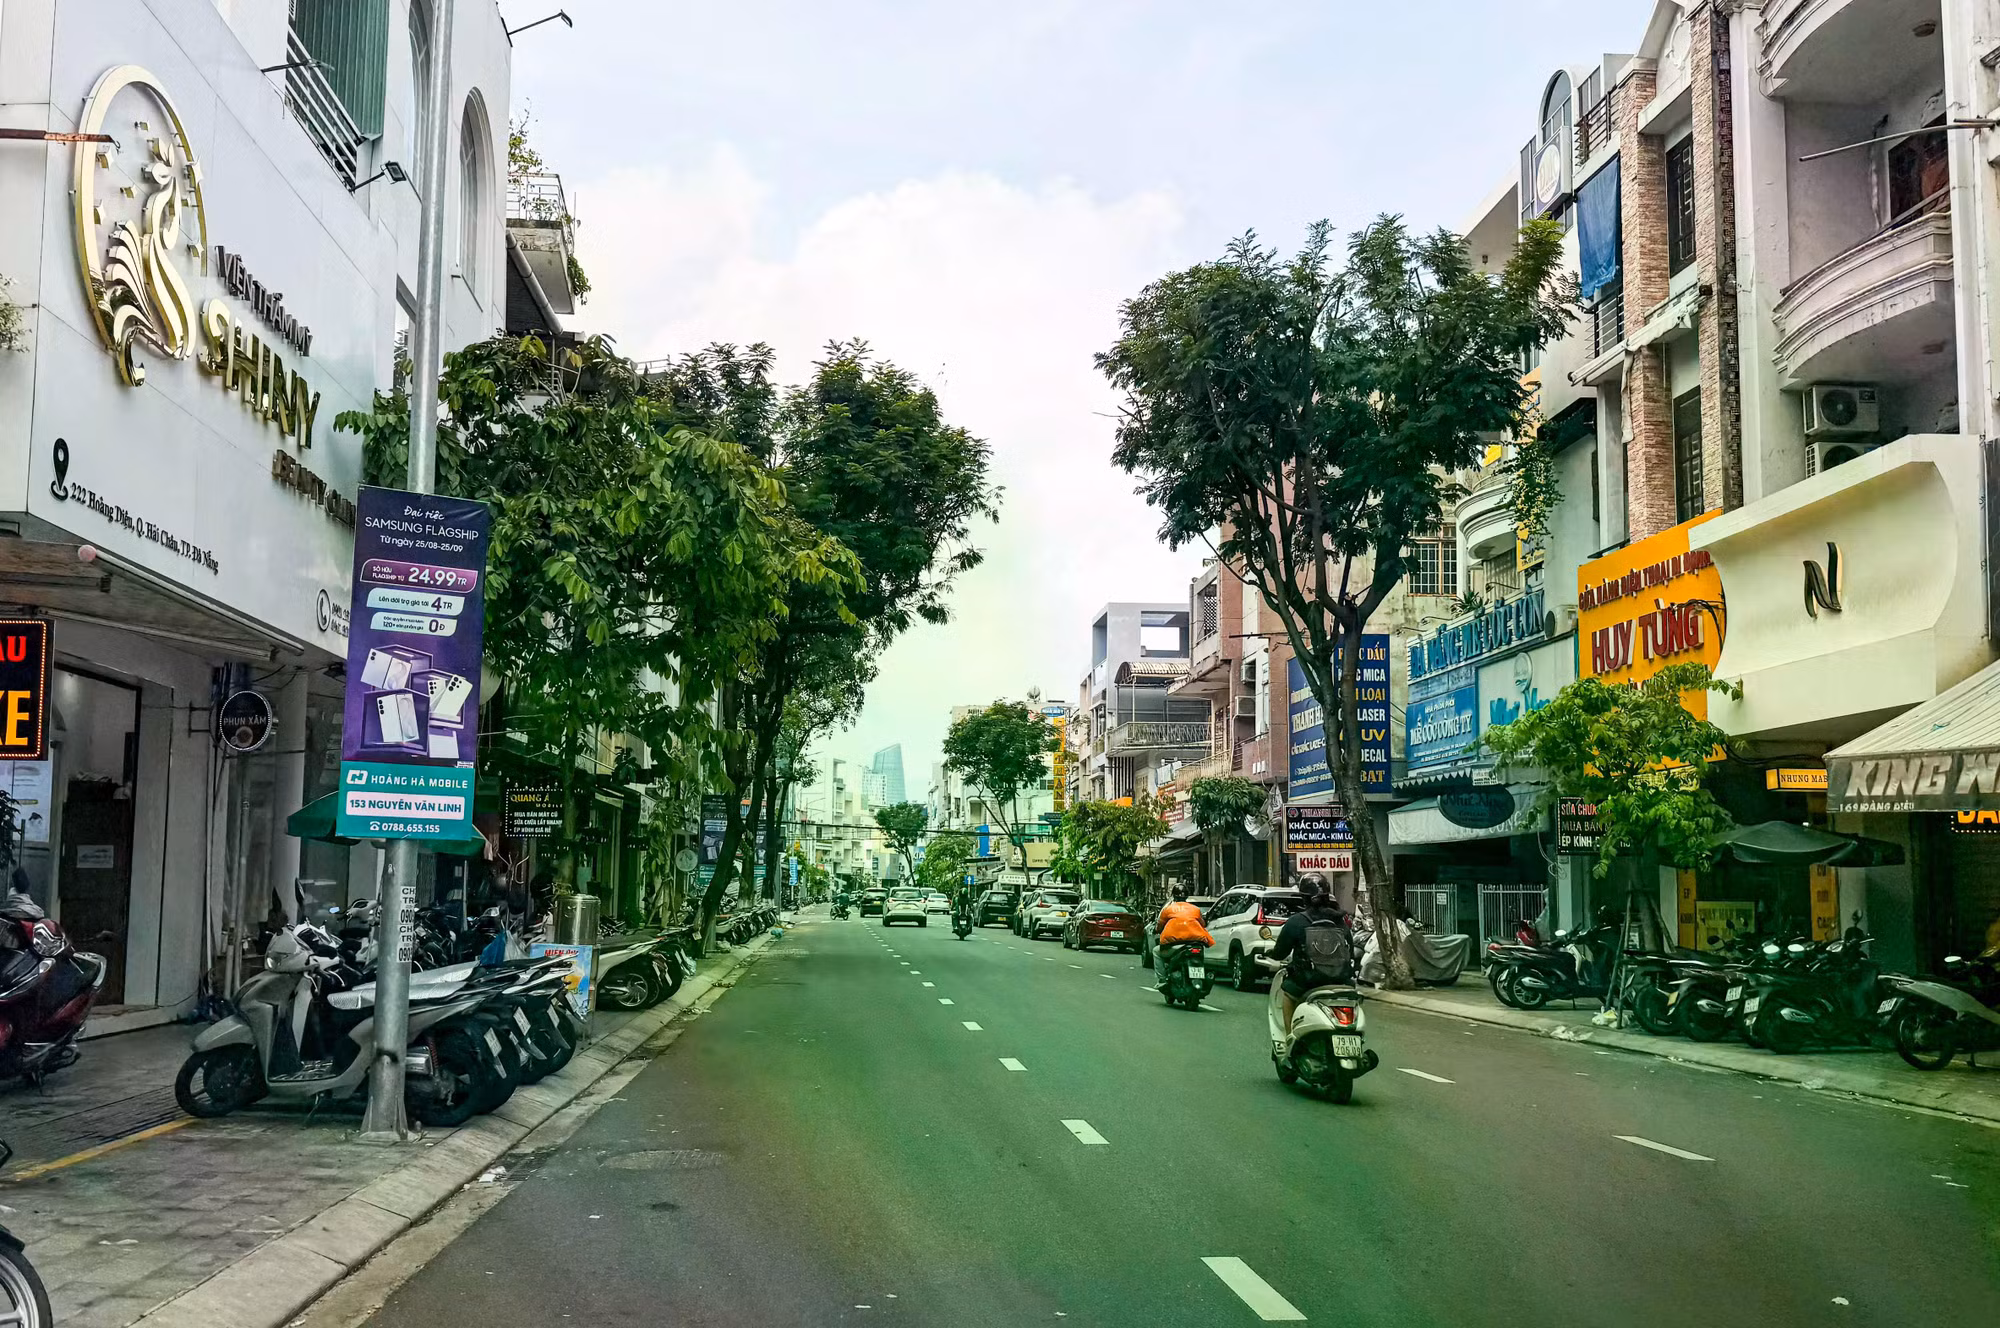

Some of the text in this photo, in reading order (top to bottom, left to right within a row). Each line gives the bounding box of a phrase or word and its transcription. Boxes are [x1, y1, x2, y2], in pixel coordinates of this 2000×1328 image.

[199, 298, 320, 449] SHINY
[272, 449, 327, 505] BEAUTY
[404, 505, 445, 522] Đại tiệc
[69, 482, 86, 505] 222
[136, 517, 145, 538] Q.
[180, 539, 192, 558] TP.
[191, 545, 202, 564] Đà
[365, 517, 479, 541] SAMSUNG FLAGSHIP
[380, 535, 463, 553] Từ ngày 25/08-25/09
[408, 567, 467, 587] 24.99 TR
[1621, 567, 1645, 599] ĐIỆN
[1643, 558, 1672, 589] THOẠI
[1671, 554, 1685, 579] DI
[430, 596, 442, 612] 4
[442, 602, 453, 610] TR
[428, 619, 439, 633] 0
[1592, 598, 1704, 675] HUY TÙNG
[0, 635, 27, 662] U
[1366, 642, 1386, 661] DẤU
[1363, 668, 1386, 682] MICA
[1361, 688, 1386, 703] LOẠI
[0, 690, 31, 746] E
[223, 716, 246, 726] PHUN
[1357, 708, 1386, 721] LASER
[1460, 713, 1473, 735] TY
[1361, 728, 1386, 742] UV
[371, 773, 468, 788] HOÀNG HÀ MOBILE
[1780, 773, 1809, 783] NHUNG
[1844, 752, 2000, 798] KING W
[349, 798, 461, 812] 153 NGUYỄN VĂN LINH
[510, 793, 542, 803] QUANG
[1301, 808, 1331, 818] THANH
[1838, 802, 1859, 813] 169
[381, 822, 440, 833] 0788.655.155
[1312, 819, 1331, 829] DẤU
[1561, 821, 1582, 832] MUA
[1308, 832, 1327, 840] MICA
[1330, 832, 1344, 840] KIM
[1561, 833, 1571, 847] ÉP
[1573, 834, 1593, 847] KÍNH
[1329, 853, 1350, 869] DẤU
